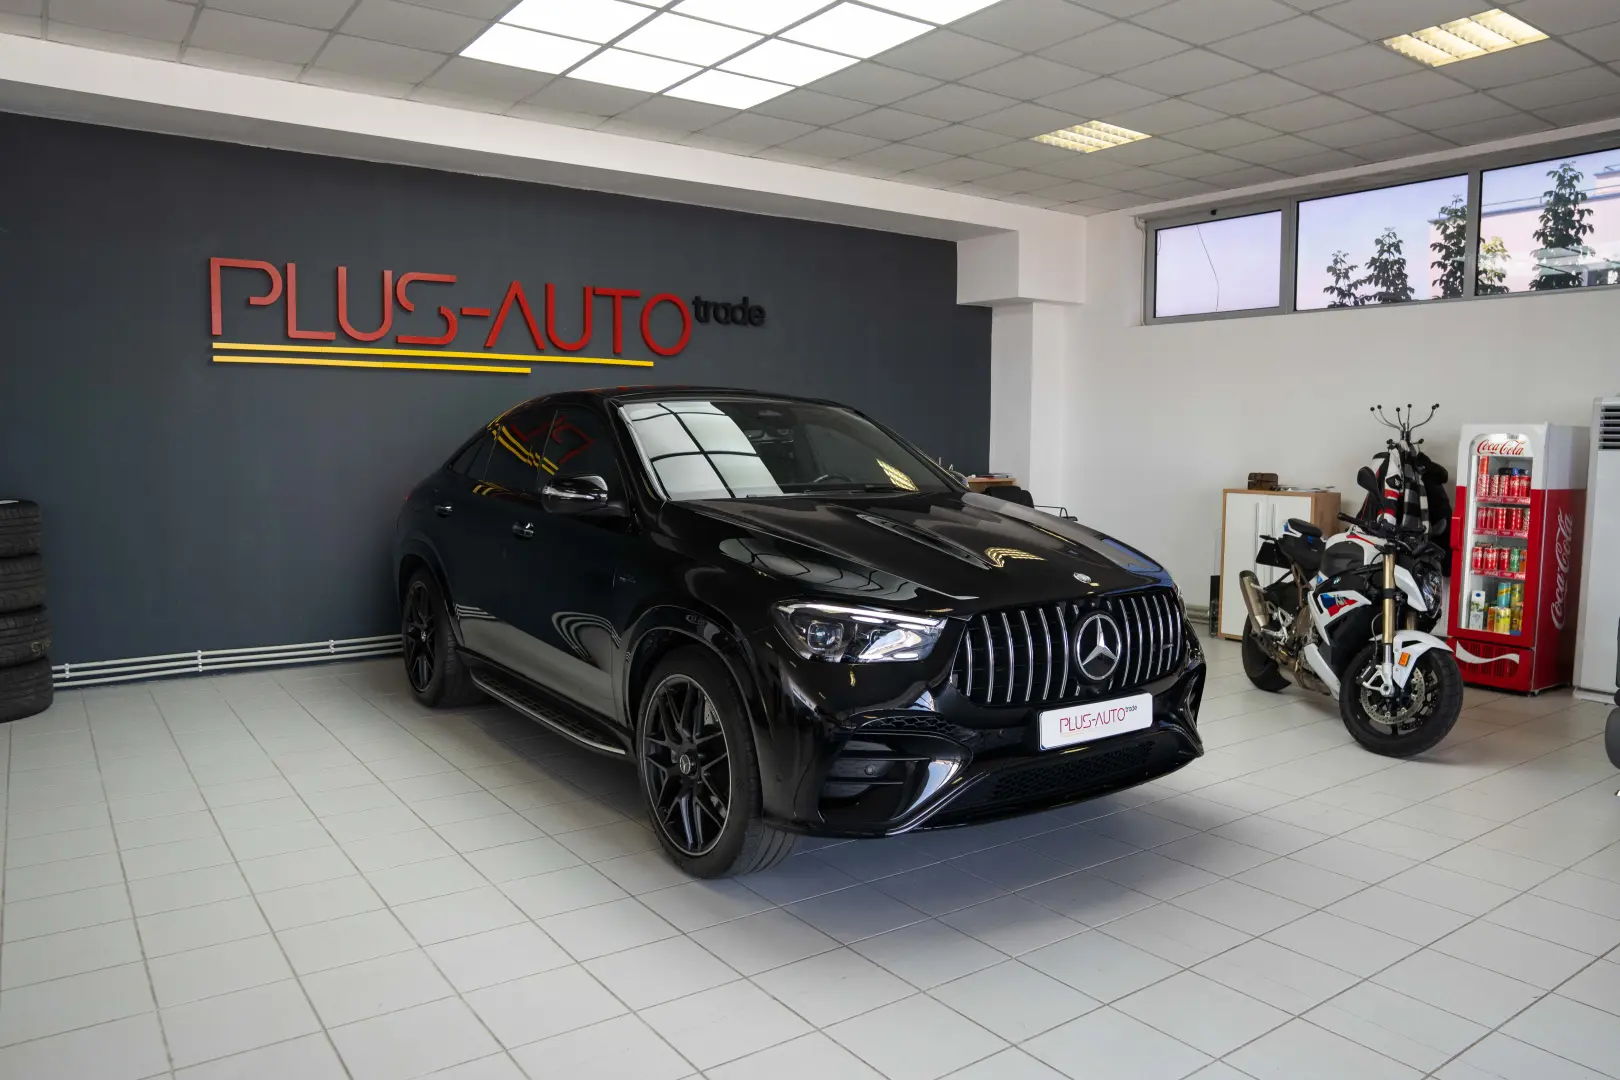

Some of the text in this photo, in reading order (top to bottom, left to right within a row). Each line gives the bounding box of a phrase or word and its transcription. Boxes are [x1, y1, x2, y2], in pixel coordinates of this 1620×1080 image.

[209, 256, 766, 356] PLUS-AUTO trade
[1477, 439, 1526, 455] Coca-Cola
[1551, 507, 1573, 630] Coca-Cola
[1059, 704, 1138, 733] PLUS-AUTO trade
